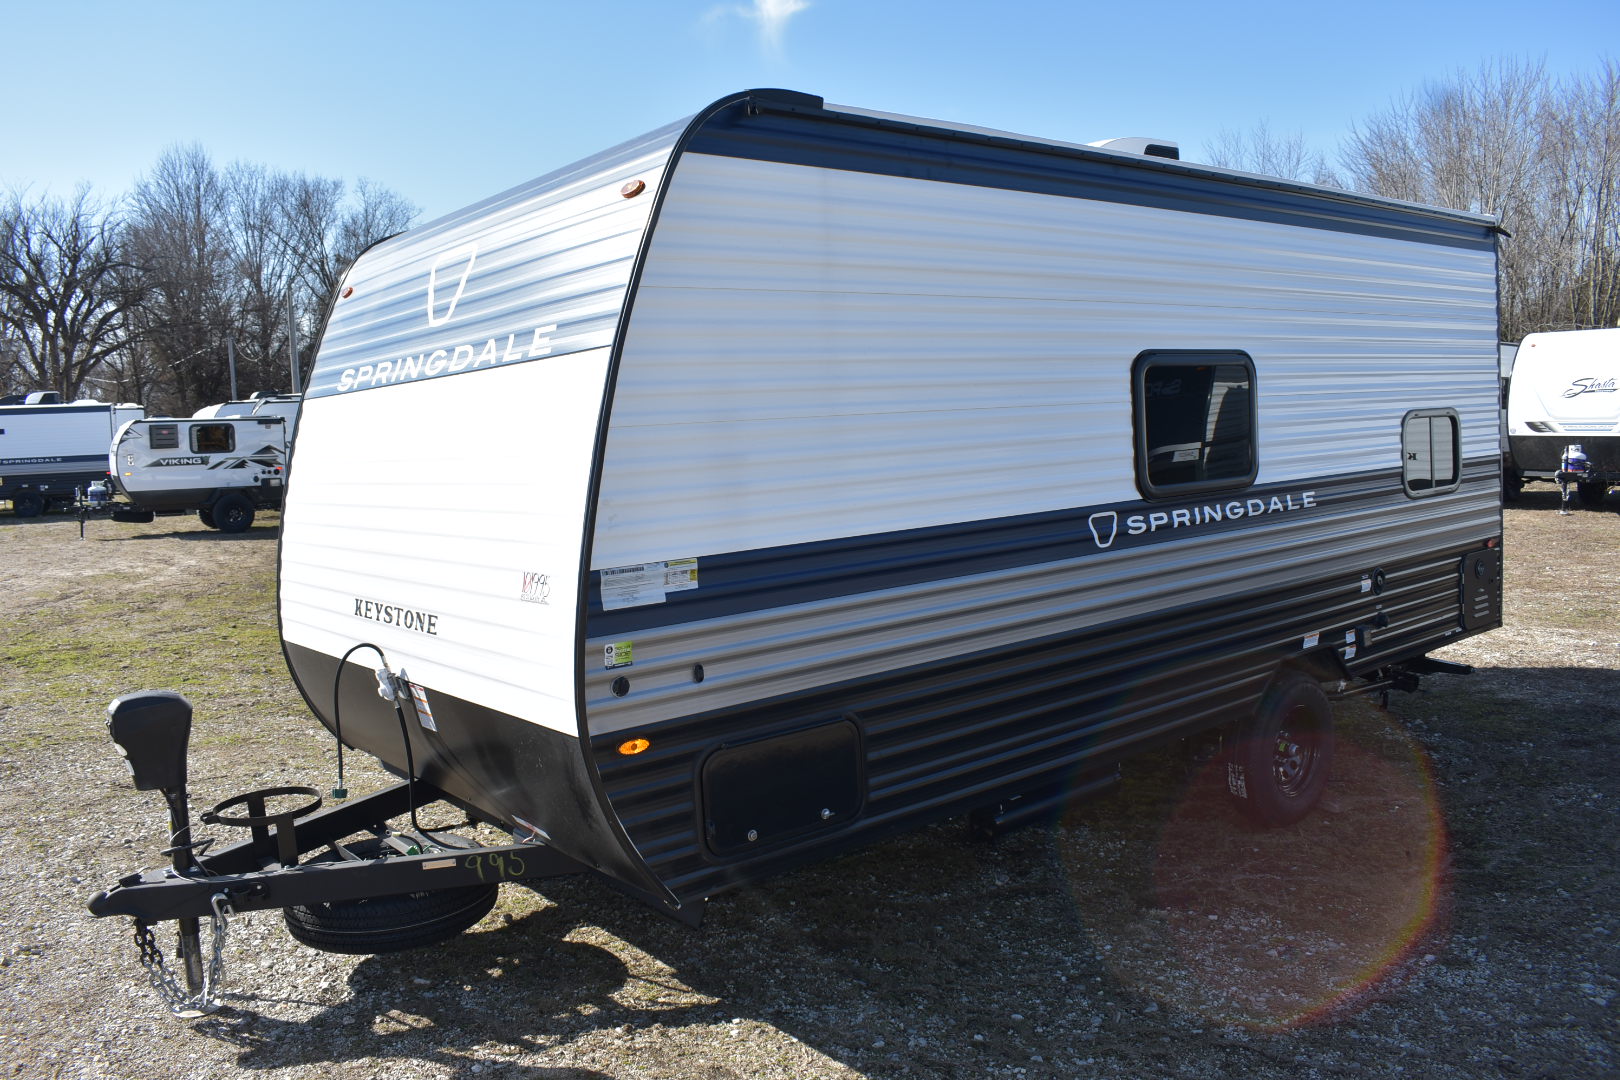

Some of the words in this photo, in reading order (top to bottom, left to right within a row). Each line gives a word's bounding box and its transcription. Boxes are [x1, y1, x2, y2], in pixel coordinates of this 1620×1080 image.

[336, 323, 558, 393] SPRINGDALE
[1561, 377, 1617, 399] Shasta
[2, 457, 63, 465] SPRINGDALE
[160, 457, 202, 466] VIKING
[1126, 491, 1317, 535] SPRINGDALE
[354, 598, 439, 636] KEYSTONE
